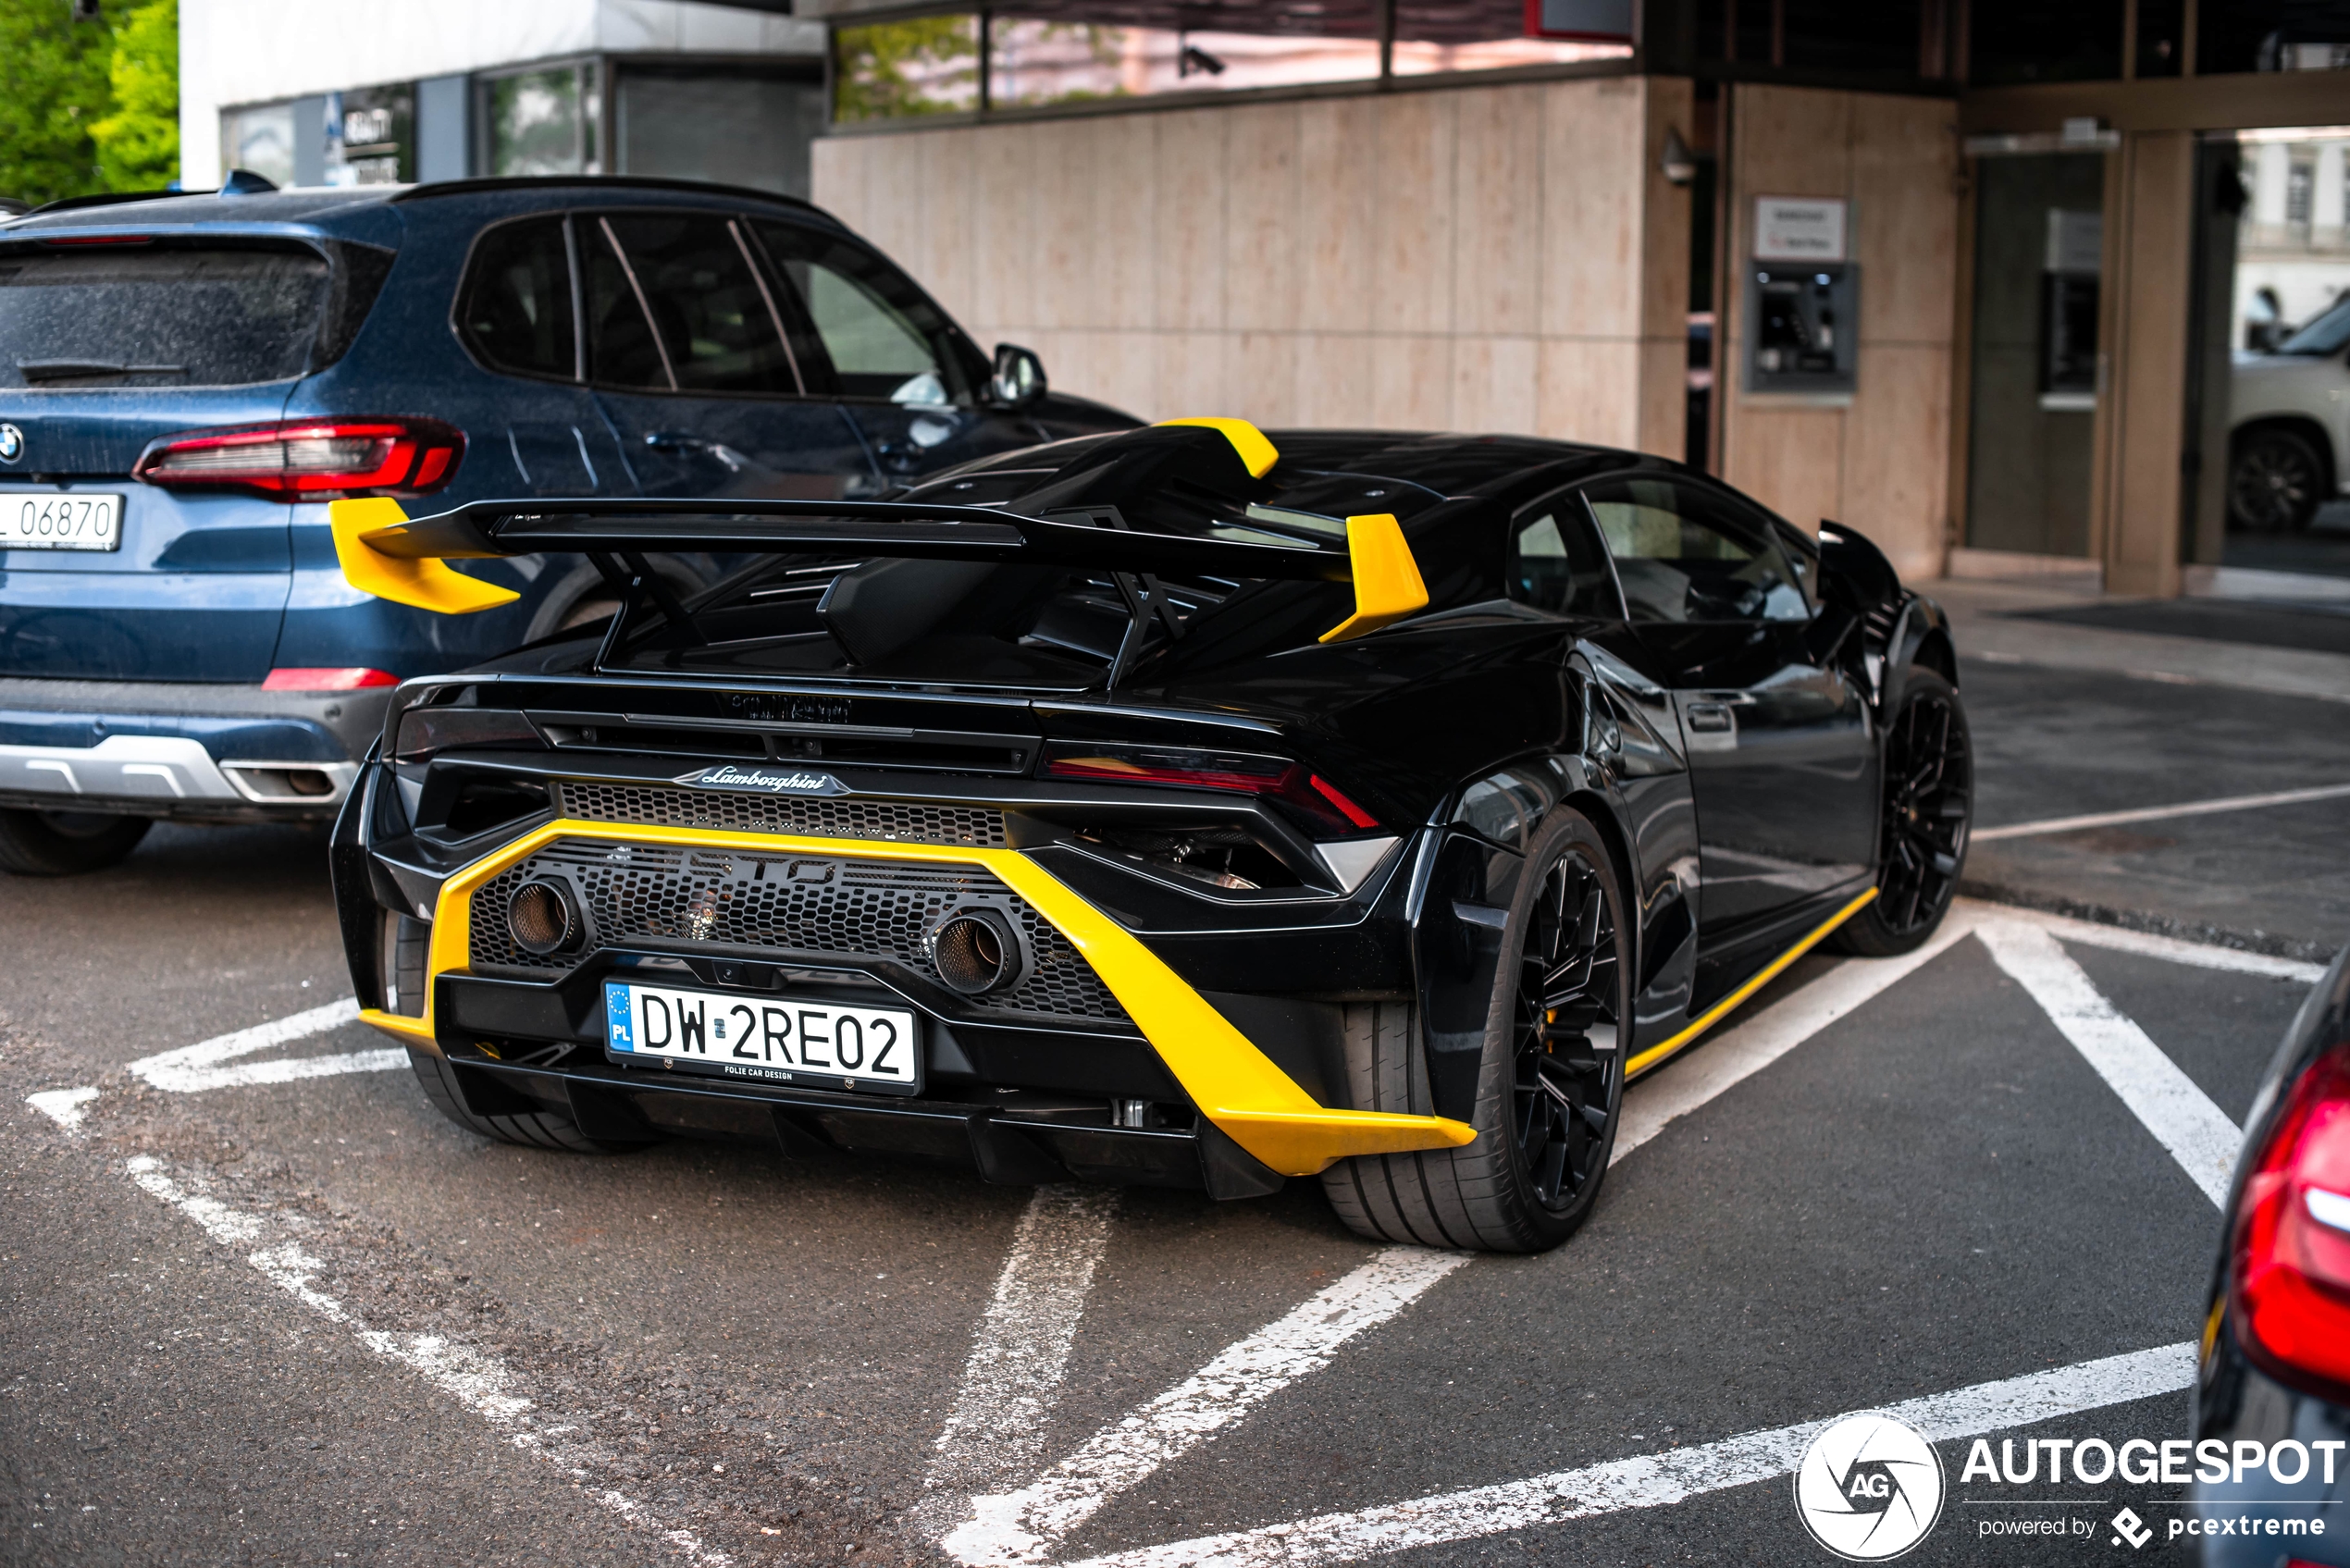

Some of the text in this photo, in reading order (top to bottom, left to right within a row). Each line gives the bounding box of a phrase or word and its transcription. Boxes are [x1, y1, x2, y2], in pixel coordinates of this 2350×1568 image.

[20, 500, 110, 537] 06870
[701, 765, 828, 792] Lamborghini
[688, 852, 836, 885] STO
[612, 1024, 631, 1042] PL
[641, 994, 899, 1075] DW 2RE02
[724, 1066, 793, 1080] FOLIE CAR DESIGN
